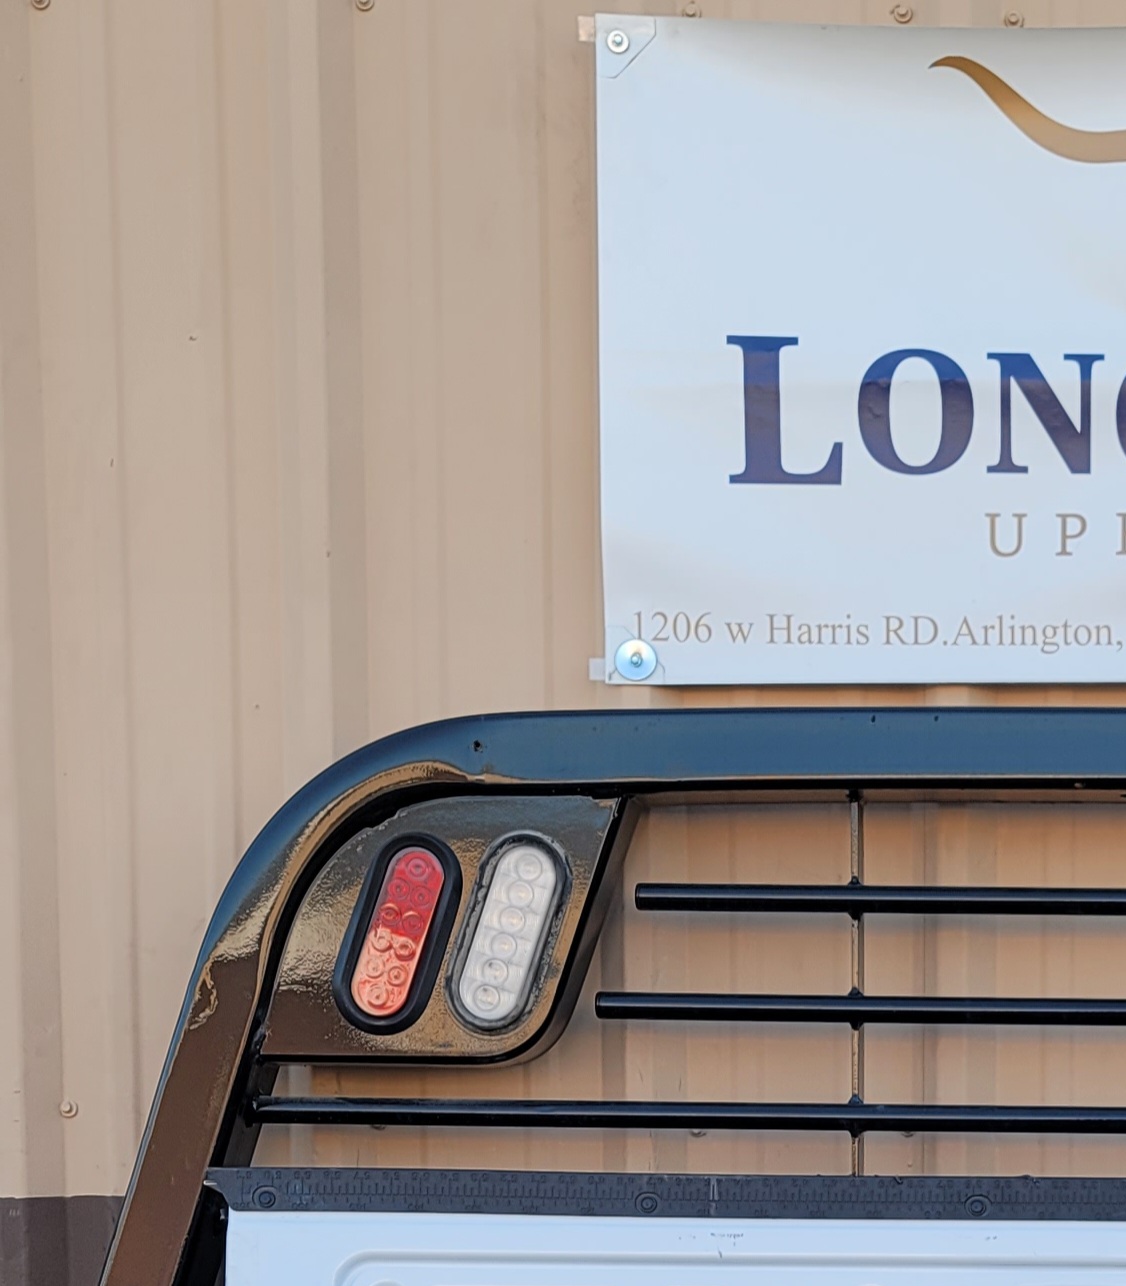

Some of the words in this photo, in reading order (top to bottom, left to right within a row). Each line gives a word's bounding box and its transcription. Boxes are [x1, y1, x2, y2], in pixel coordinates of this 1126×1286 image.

[633, 611, 713, 643] 1206
[725, 623, 754, 643] w
[766, 614, 870, 645] Harris
